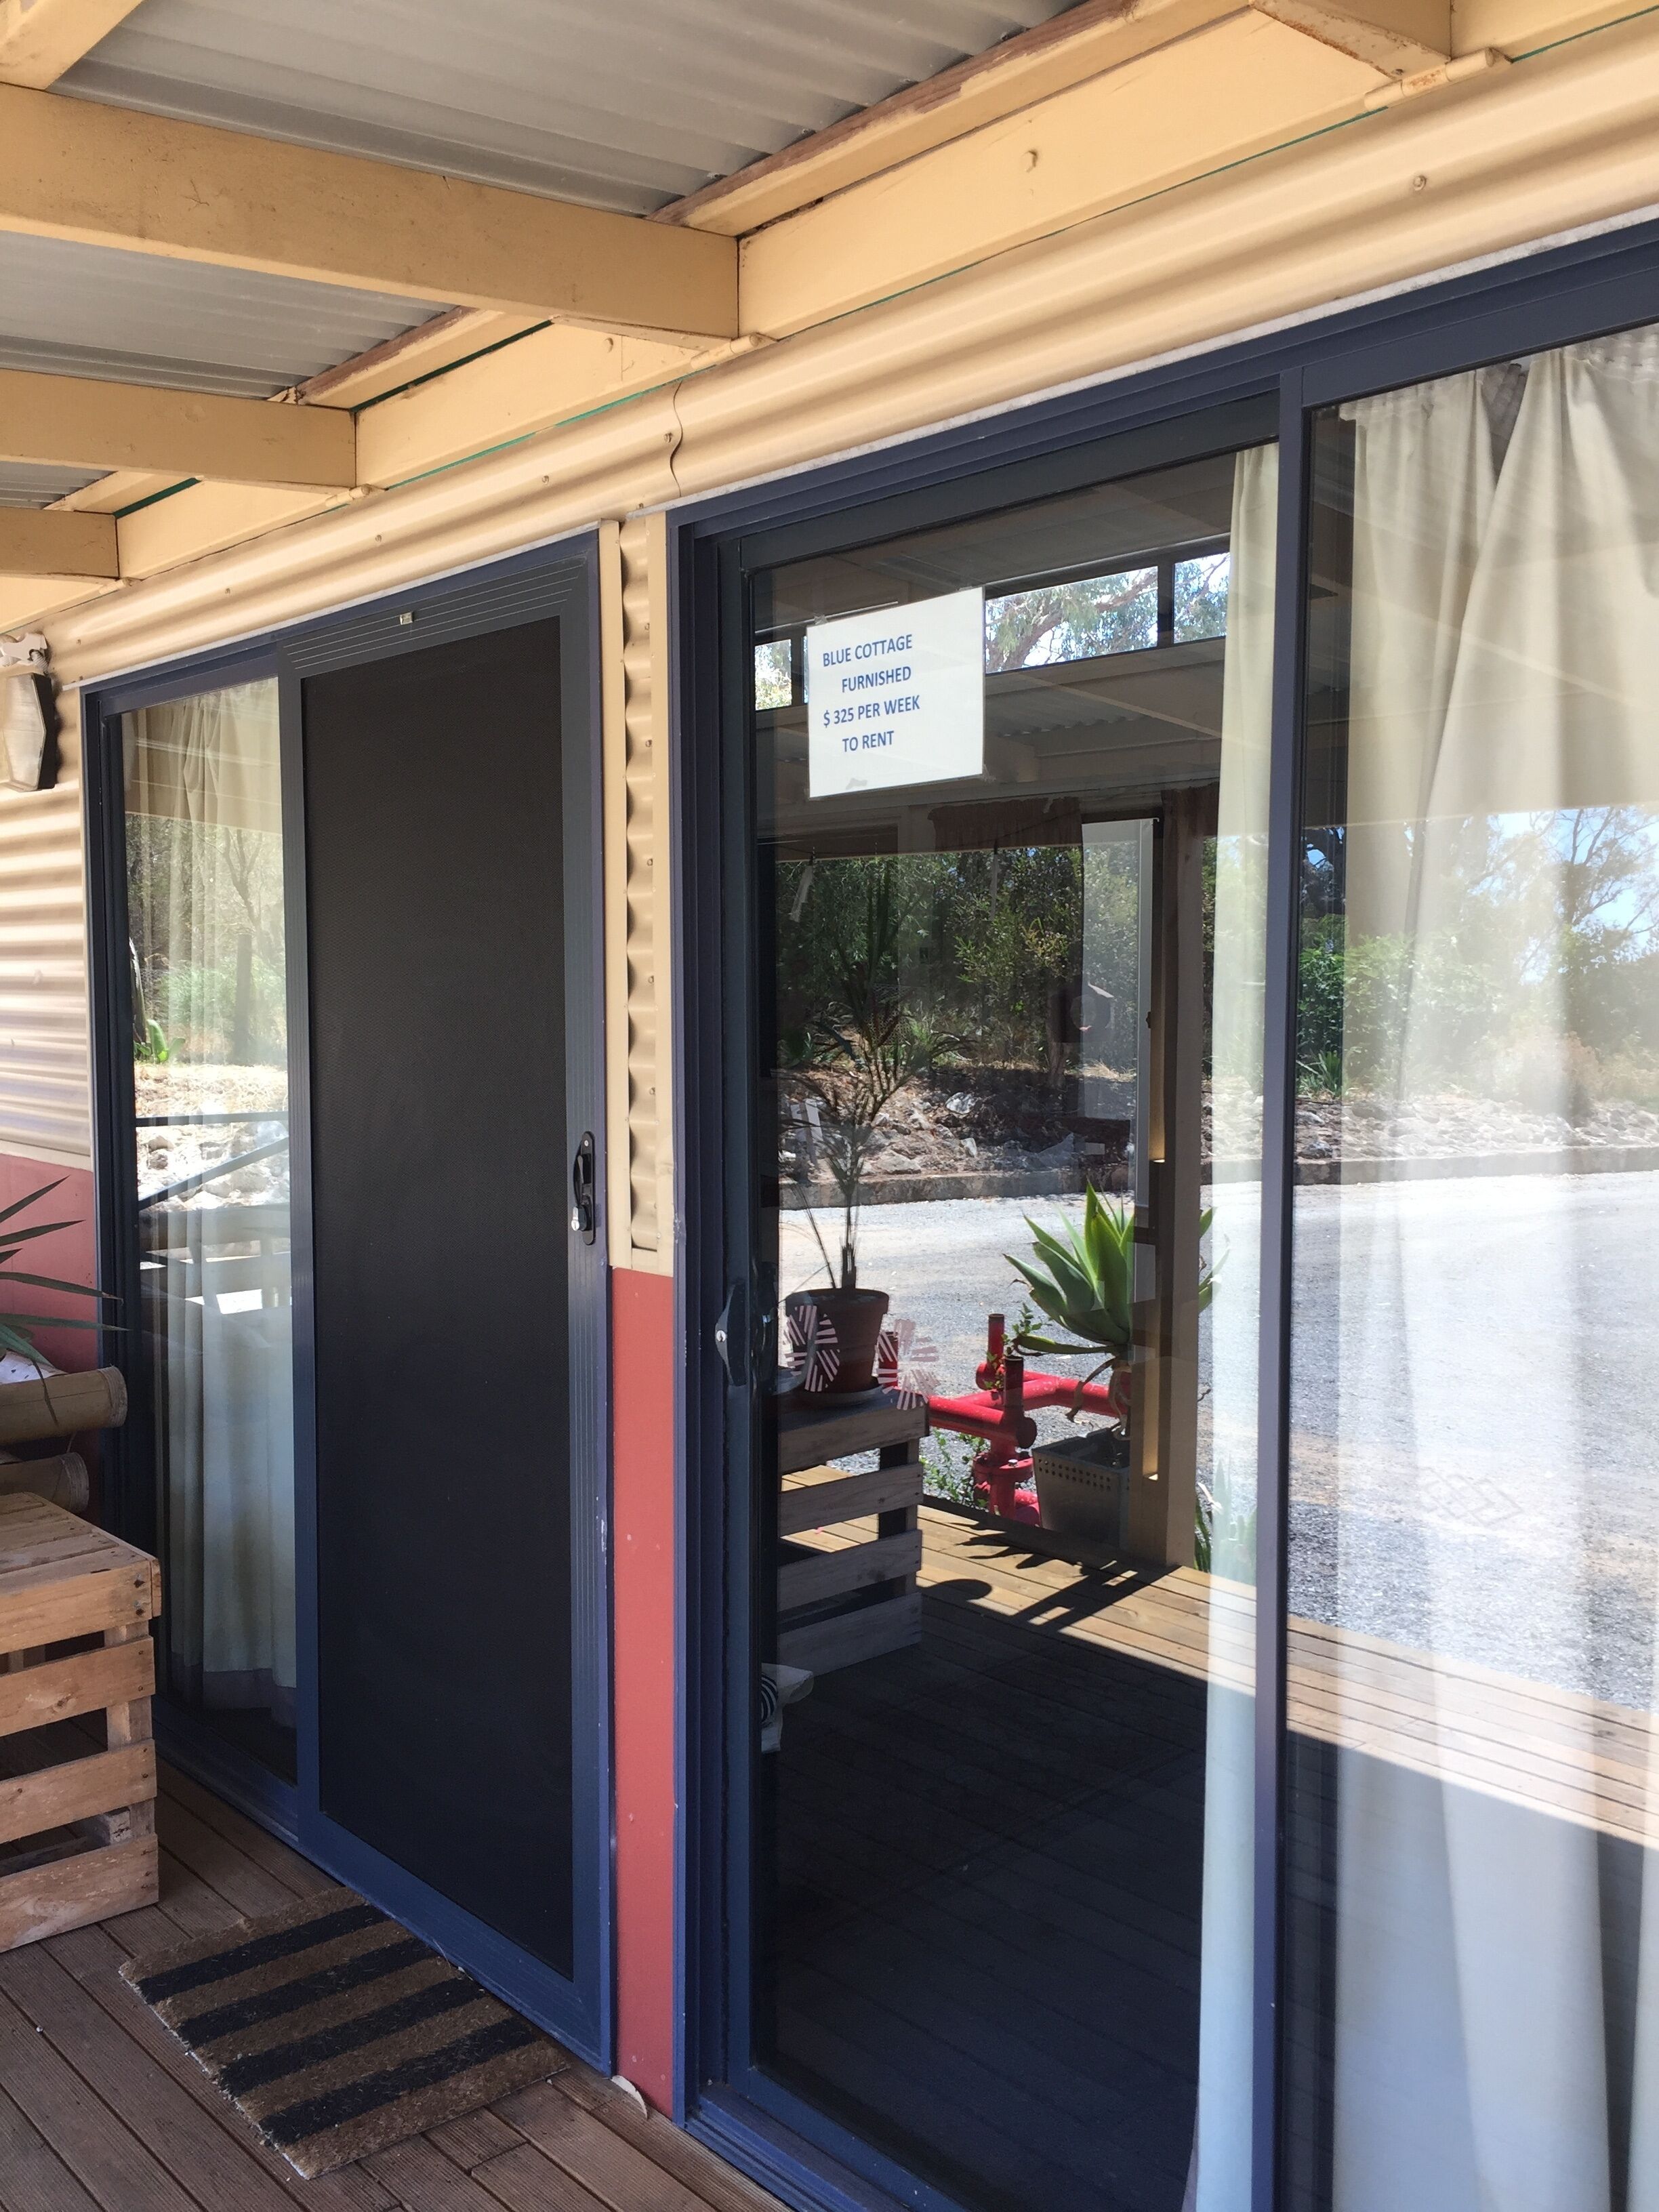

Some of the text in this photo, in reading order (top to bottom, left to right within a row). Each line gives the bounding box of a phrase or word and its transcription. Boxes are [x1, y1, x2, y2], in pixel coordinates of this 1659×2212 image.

[823, 634, 913, 668] BLUE COTTAGE
[842, 665, 912, 693] FURNISHED
[857, 702, 880, 720] PER
[884, 695, 920, 716] WEEK
[842, 730, 895, 752] TO RENT
